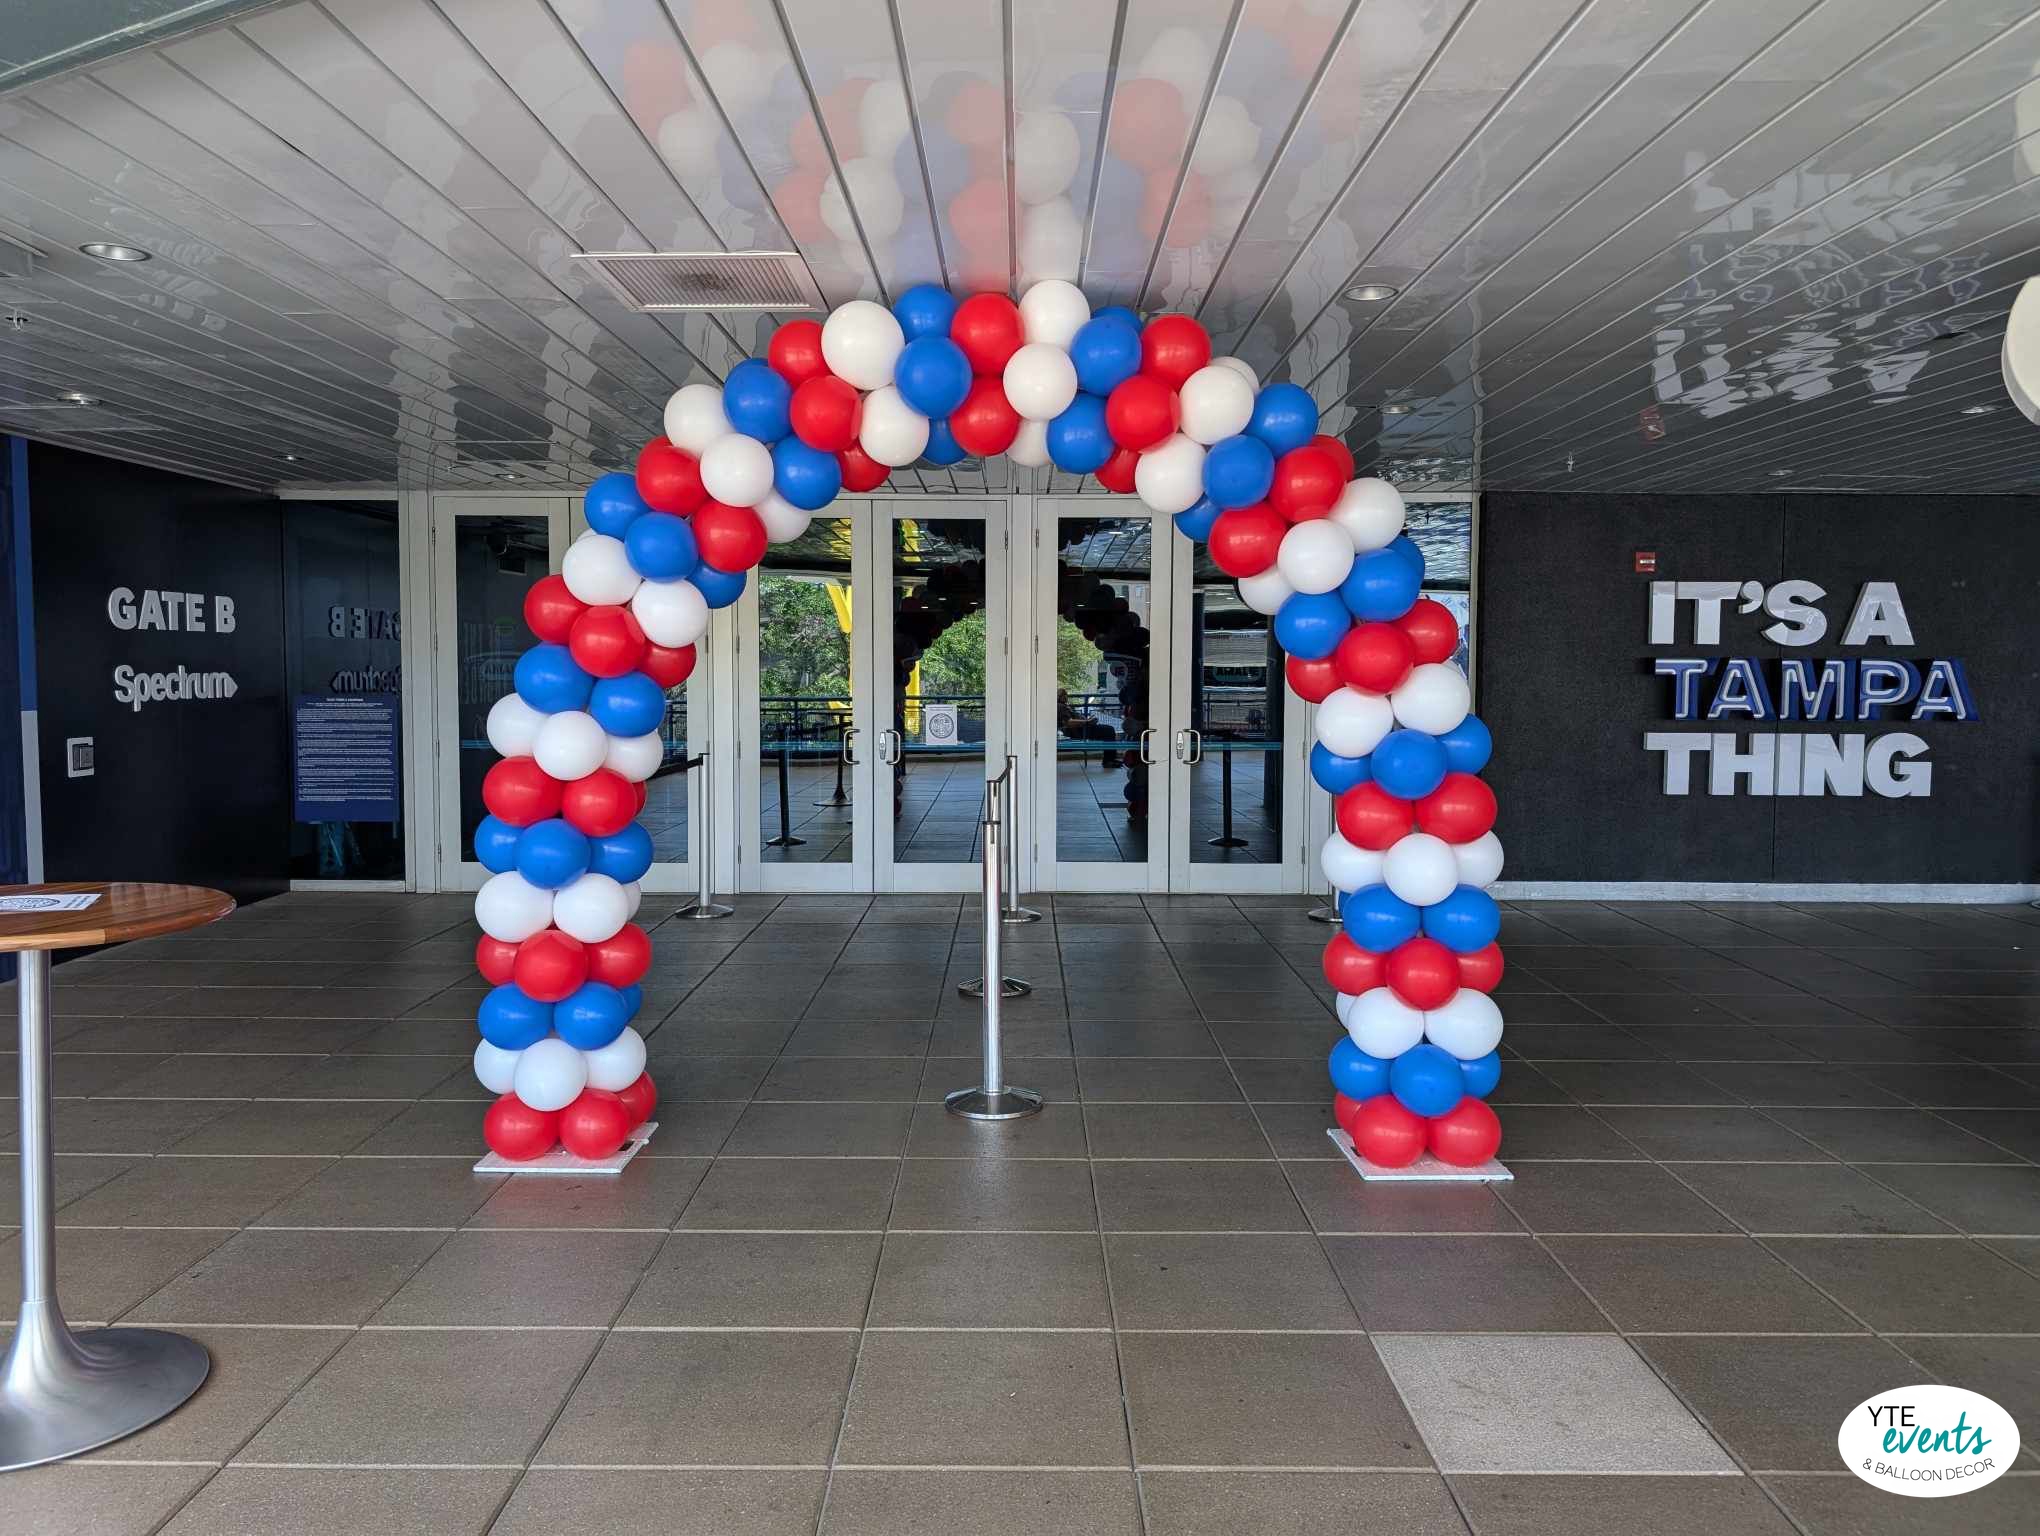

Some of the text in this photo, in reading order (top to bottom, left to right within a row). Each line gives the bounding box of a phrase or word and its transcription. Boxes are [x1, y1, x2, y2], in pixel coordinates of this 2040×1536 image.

[108, 586, 236, 633] GATE B
[1649, 579, 1915, 647] IT'S A
[114, 664, 238, 712] Spectrum
[1655, 656, 1980, 722] TAMPA
[1643, 732, 1932, 799] THING
